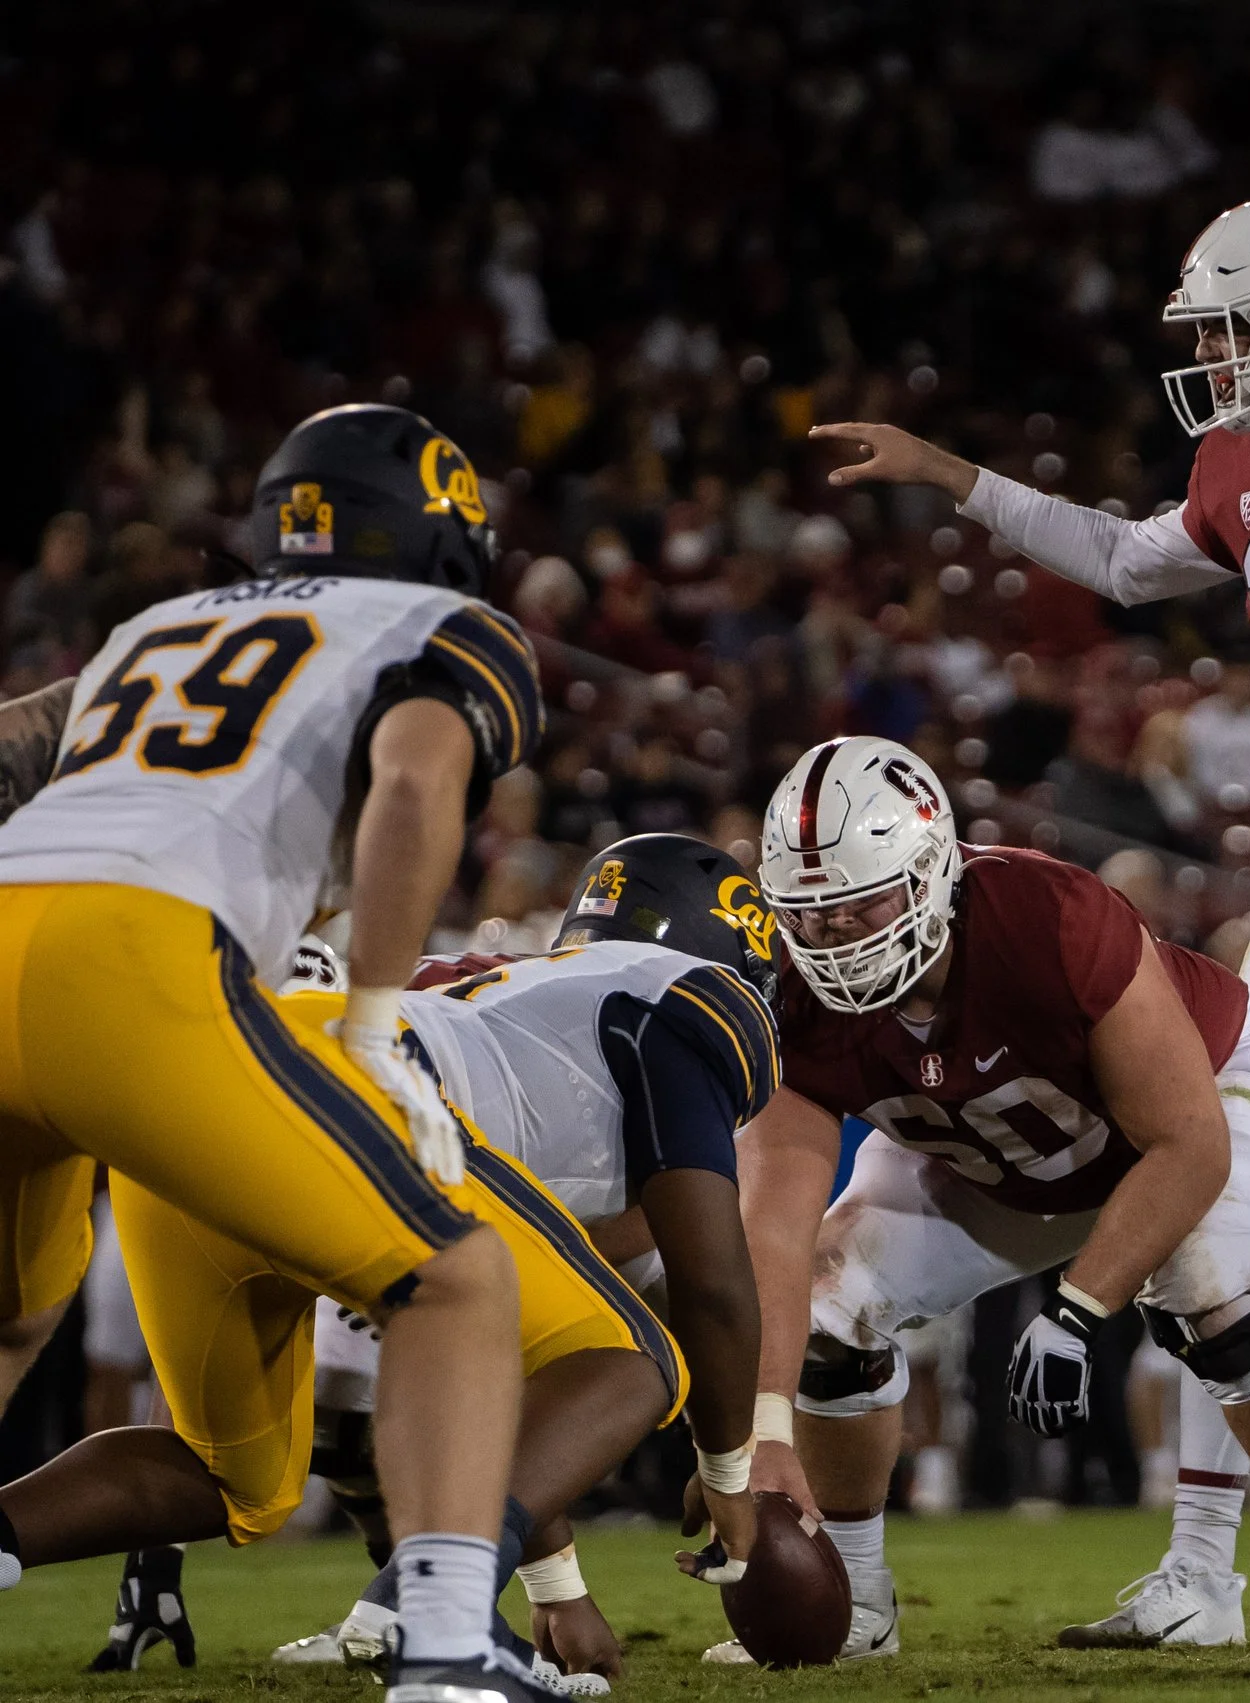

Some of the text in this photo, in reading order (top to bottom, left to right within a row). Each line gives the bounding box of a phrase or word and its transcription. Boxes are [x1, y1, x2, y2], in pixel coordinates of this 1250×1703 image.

[419, 436, 488, 525] Cal
[49, 611, 325, 786] 59
[709, 874, 777, 961] Cal
